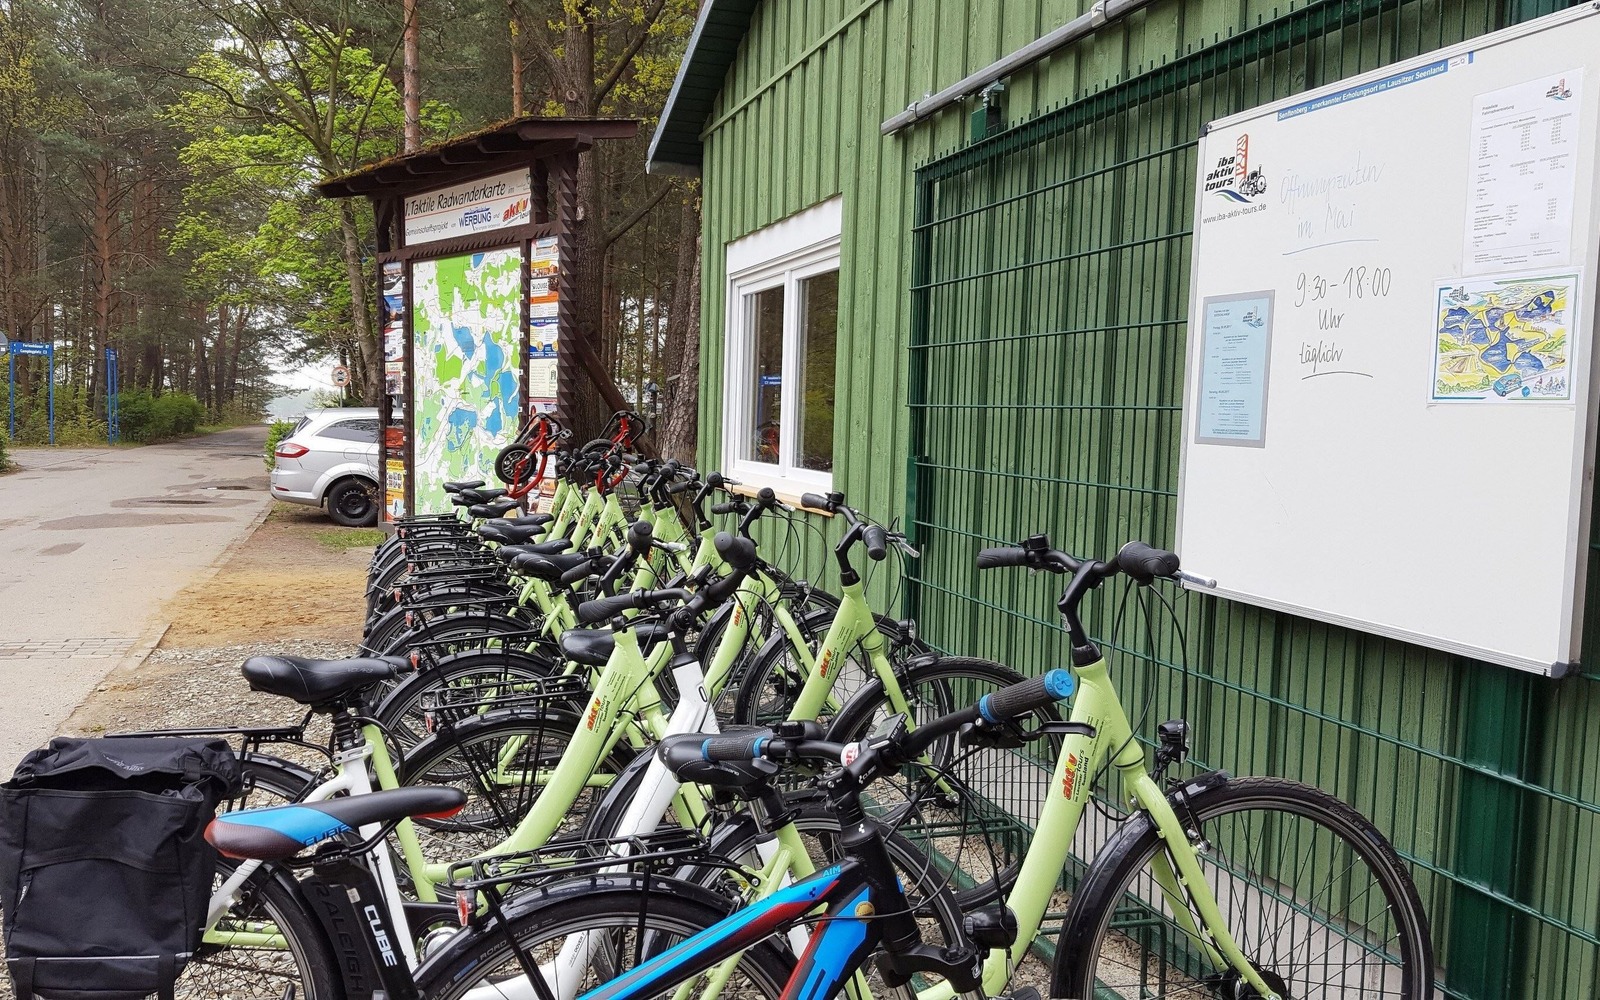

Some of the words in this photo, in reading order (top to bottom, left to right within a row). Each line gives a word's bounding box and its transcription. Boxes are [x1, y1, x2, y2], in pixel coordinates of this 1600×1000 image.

[1311, 95, 1342, 110] anerkannter
[1342, 85, 1379, 101] Erholungsort
[1379, 83, 1387, 91] im
[1387, 74, 1414, 88] Lausitzer
[1415, 64, 1444, 79] Seenland
[1206, 166, 1234, 181] aktiv
[1217, 156, 1235, 168] iba
[436, 181, 506, 210] Radwanderkarte
[1204, 177, 1234, 191] tours
[458, 212, 492, 231] WERBUNG
[502, 197, 529, 222] aktiv
[1202, 203, 1267, 224] www.iba-aktiv-tours.de
[1324, 203, 1356, 233] Mai
[1319, 308, 1344, 330] Uhr
[1299, 341, 1344, 373] täglich
[1062, 752, 1078, 800] aktiv
[303, 823, 353, 847] CUBE
[822, 865, 841, 877] AIM
[364, 904, 398, 967] CUBE
[480, 940, 507, 960] ROAD
